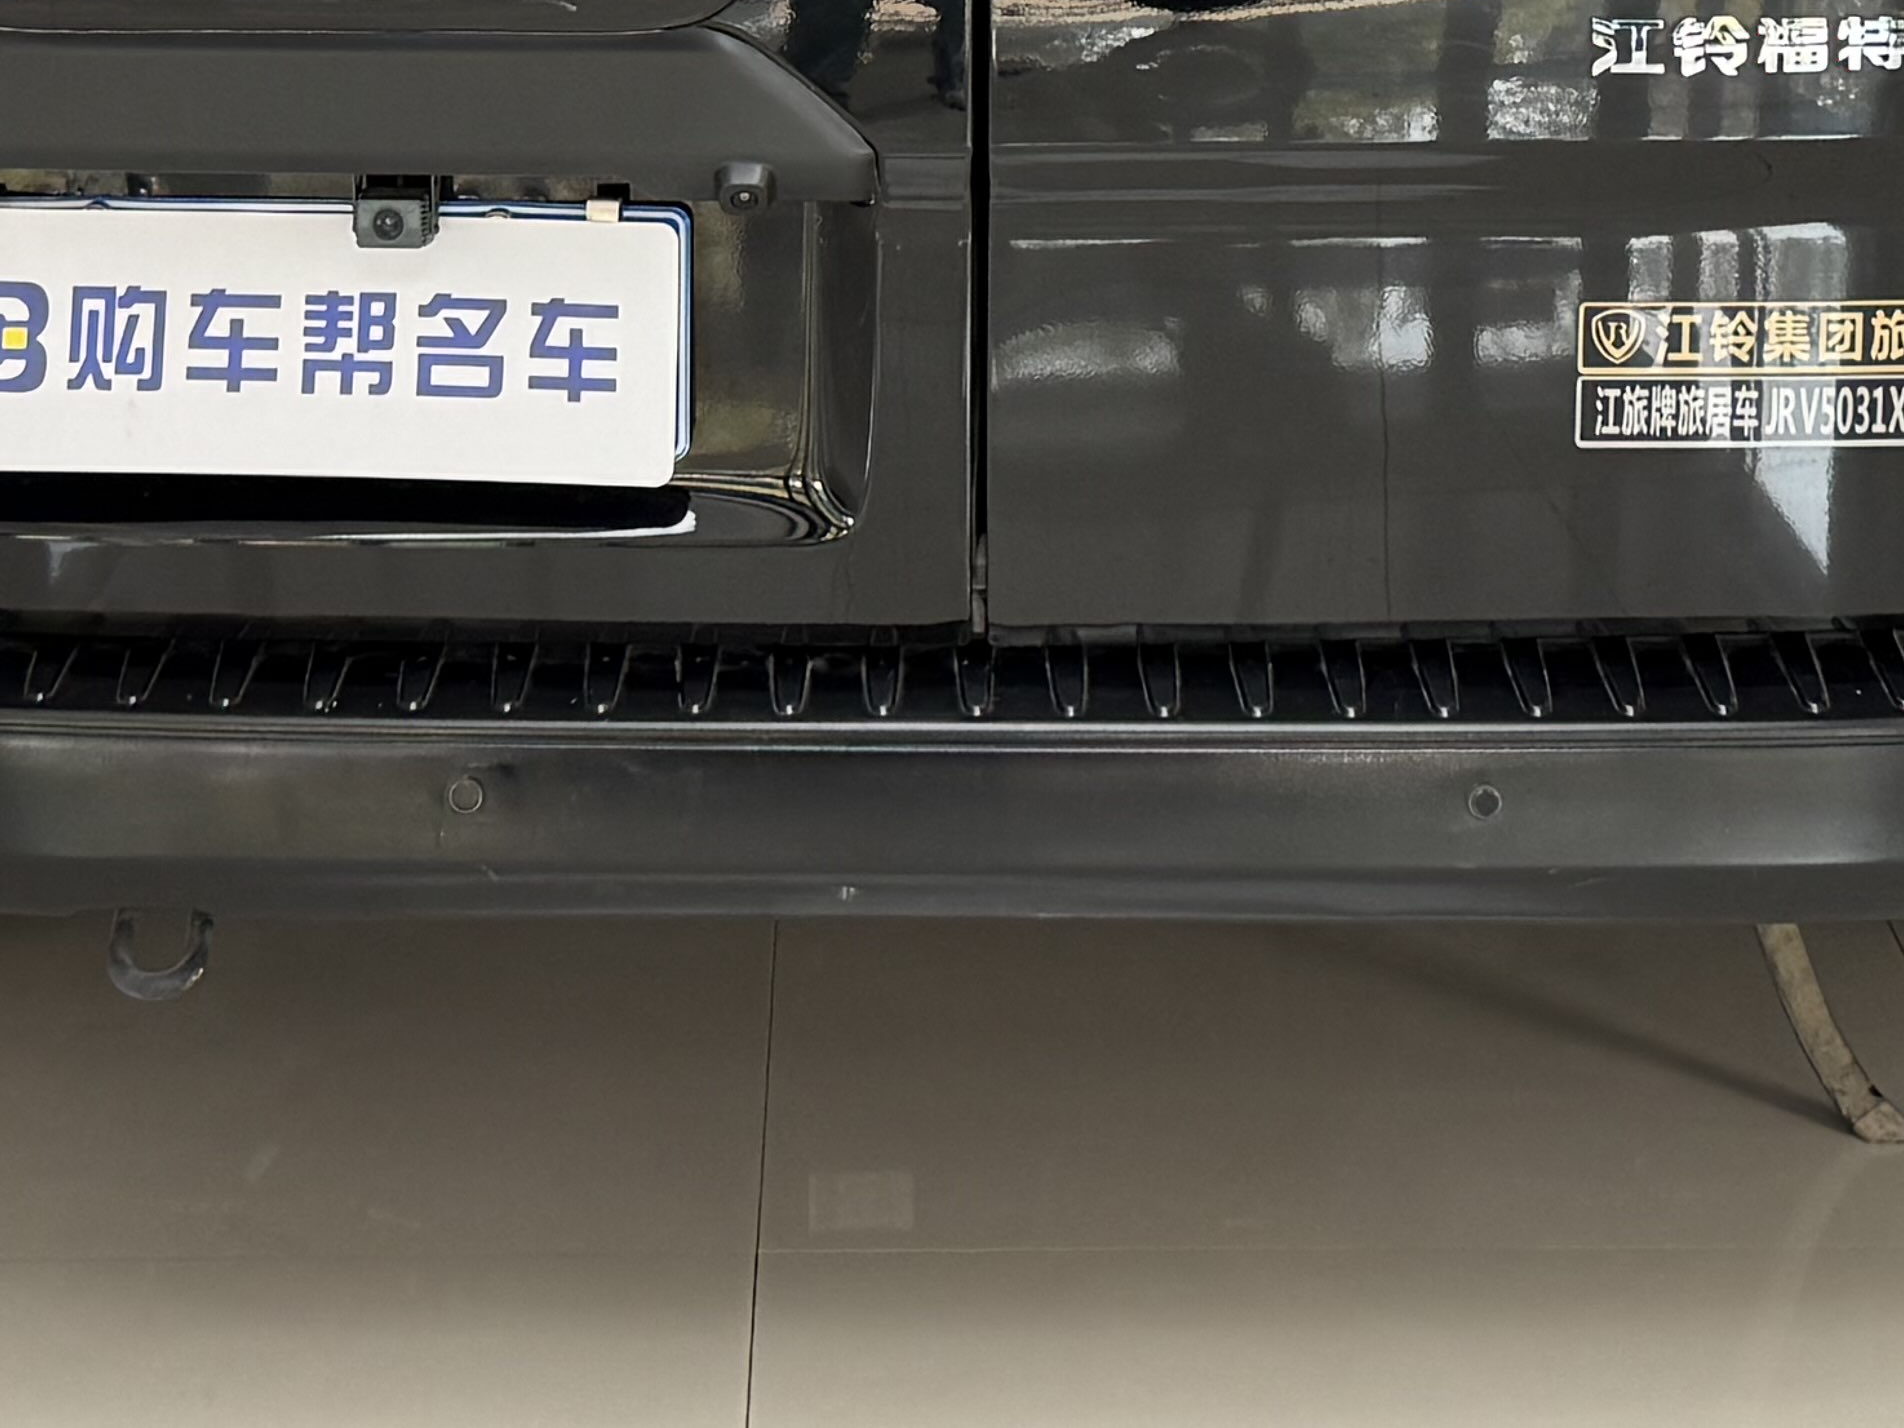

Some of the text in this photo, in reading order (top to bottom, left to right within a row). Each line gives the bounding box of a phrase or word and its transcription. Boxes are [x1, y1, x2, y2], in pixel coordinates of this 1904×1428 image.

[66, 285, 620, 403] 购车帮名车
[1595, 384, 1759, 438] 江旅牌旅居车
